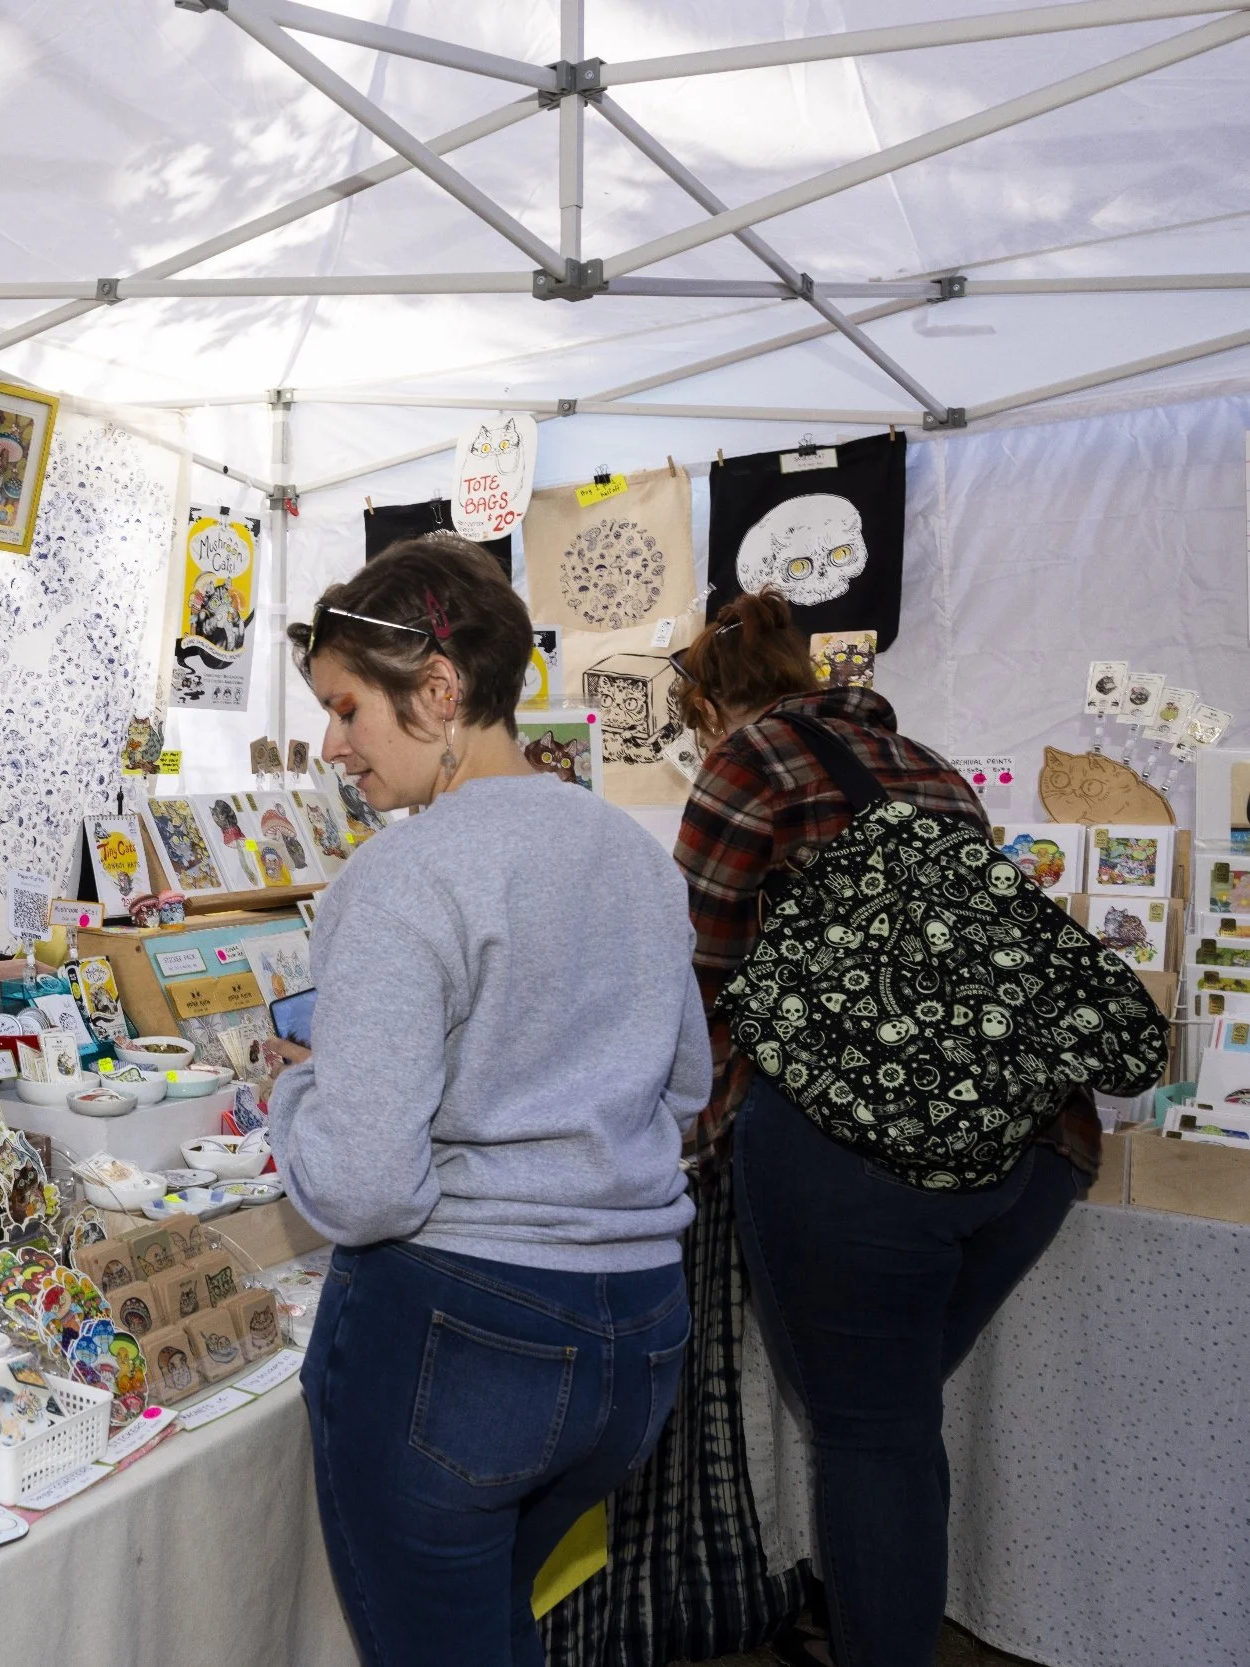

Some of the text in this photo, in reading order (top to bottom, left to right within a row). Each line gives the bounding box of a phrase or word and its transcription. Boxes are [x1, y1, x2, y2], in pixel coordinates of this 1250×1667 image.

[463, 475, 500, 494] TOTE
[464, 492, 508, 514] BAGS
[199, 532, 242, 563] Mushroom
[96, 840, 137, 862] Tiny Cats
